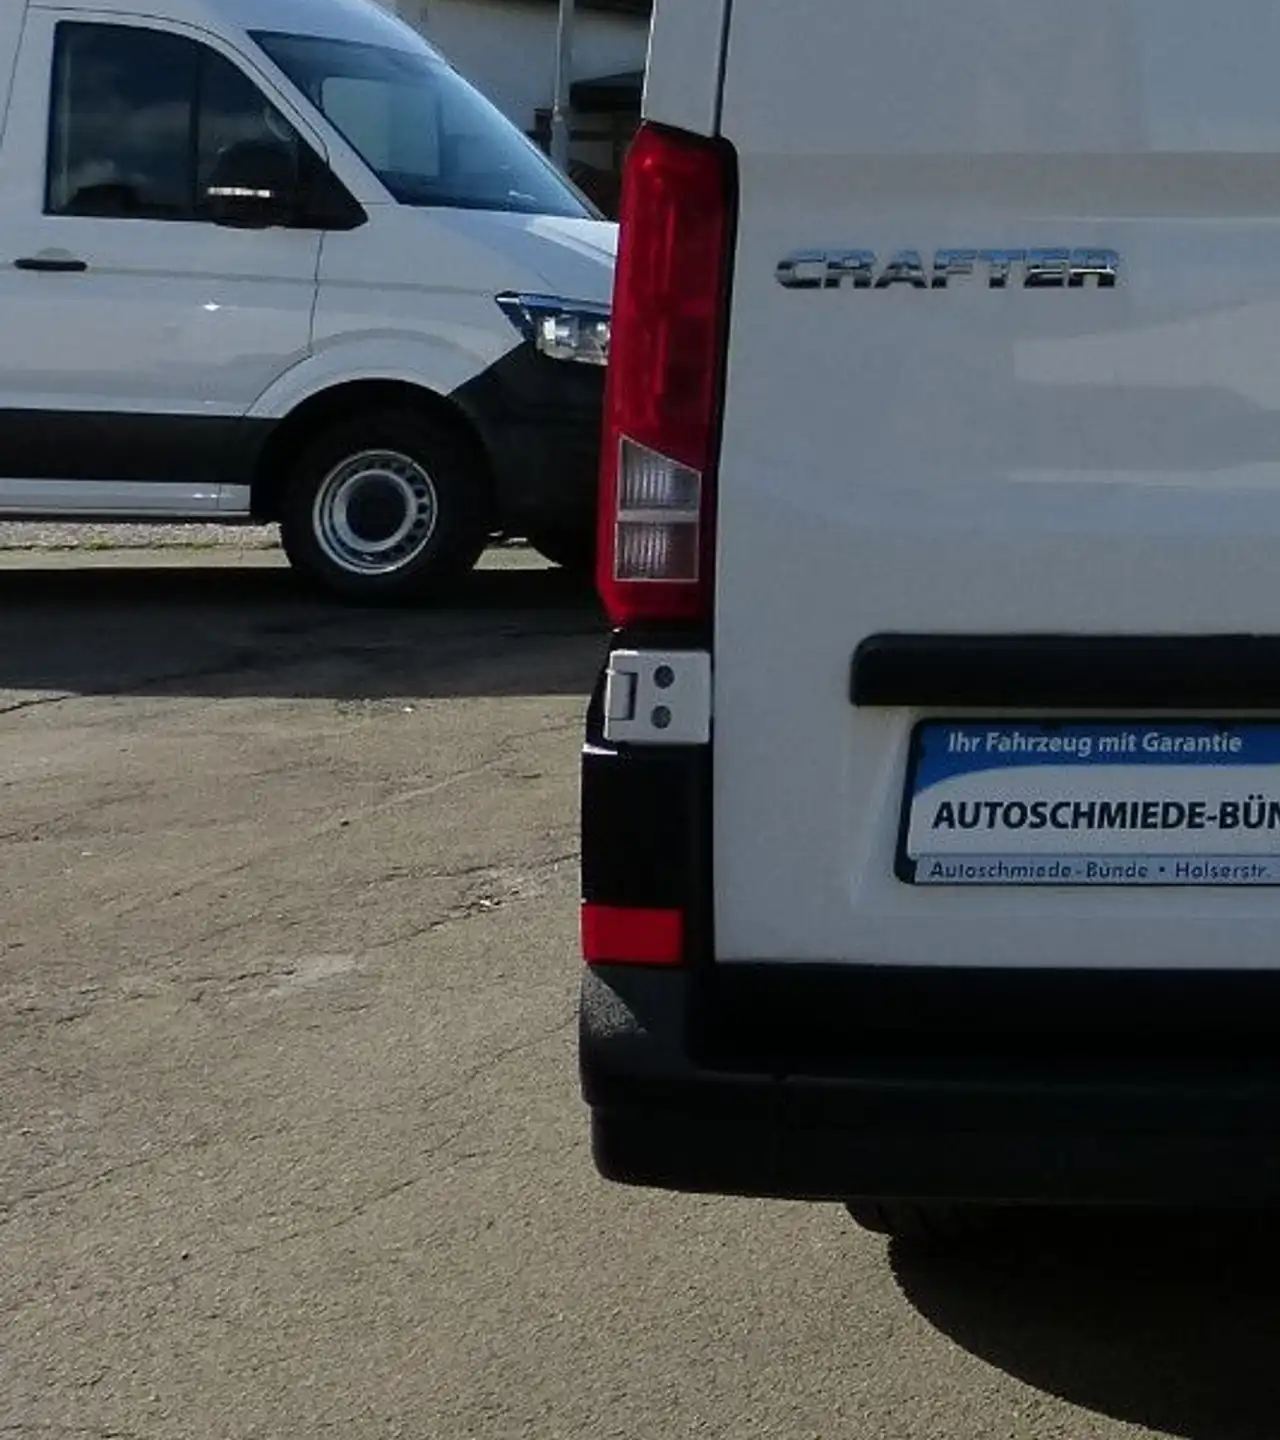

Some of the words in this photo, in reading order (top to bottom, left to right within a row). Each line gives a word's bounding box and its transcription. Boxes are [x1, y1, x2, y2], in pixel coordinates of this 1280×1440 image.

[775, 247, 1121, 289] CRAFTER
[948, 732, 981, 753] Ihr
[985, 732, 1092, 757] Fahrzeug
[1099, 732, 1137, 753] mit
[1142, 733, 1242, 754] Garantie
[1175, 861, 1271, 879] Holserstr.
